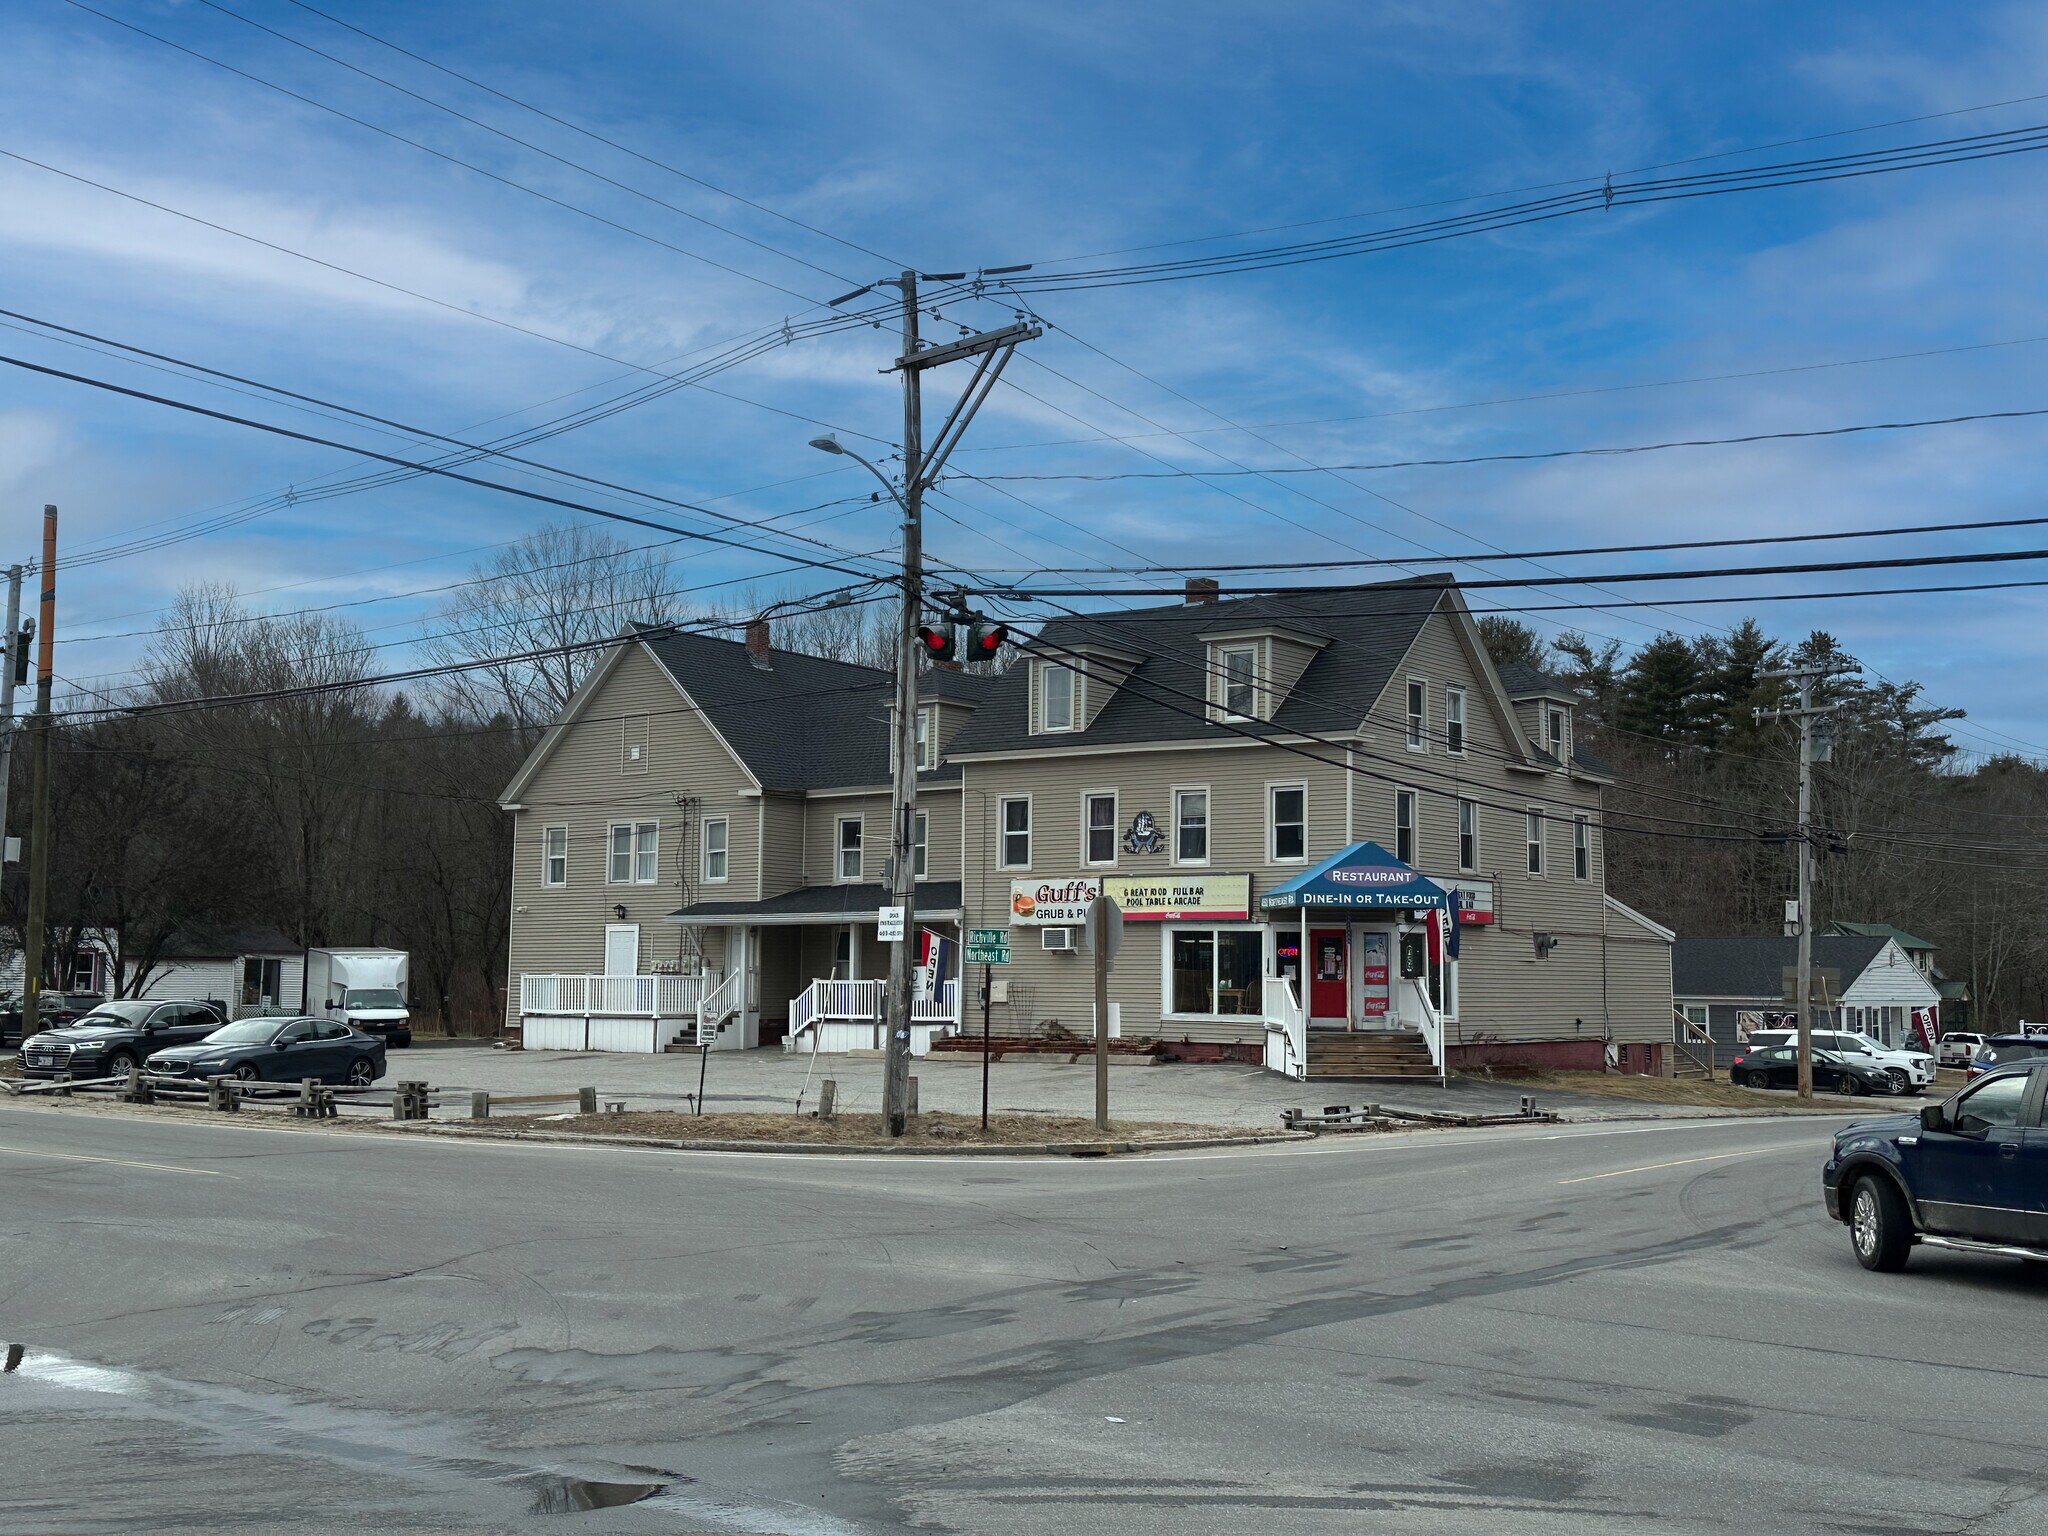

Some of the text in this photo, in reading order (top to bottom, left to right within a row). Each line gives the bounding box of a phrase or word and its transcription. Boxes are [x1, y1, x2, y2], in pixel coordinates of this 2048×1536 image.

[1332, 870, 1412, 882] RESTAURANT
[1035, 881, 1097, 904] Guff's
[1150, 887, 1167, 896] FOOD
[1172, 887, 1188, 896] FULL
[1126, 898, 1144, 907] POOL
[1146, 897, 1166, 906] TABLE
[1173, 896, 1201, 905] ARCADE
[1303, 893, 1352, 904] DINE-IN
[1356, 894, 1372, 904] OR
[1376, 893, 1439, 905] TAKE-OUT
[1036, 908, 1064, 919] GRUB
[1067, 908, 1074, 919] &
[969, 930, 1008, 944] Richville Rd
[966, 948, 1010, 963] Northeast Rd
[1922, 1014, 1936, 1040] OPEN
